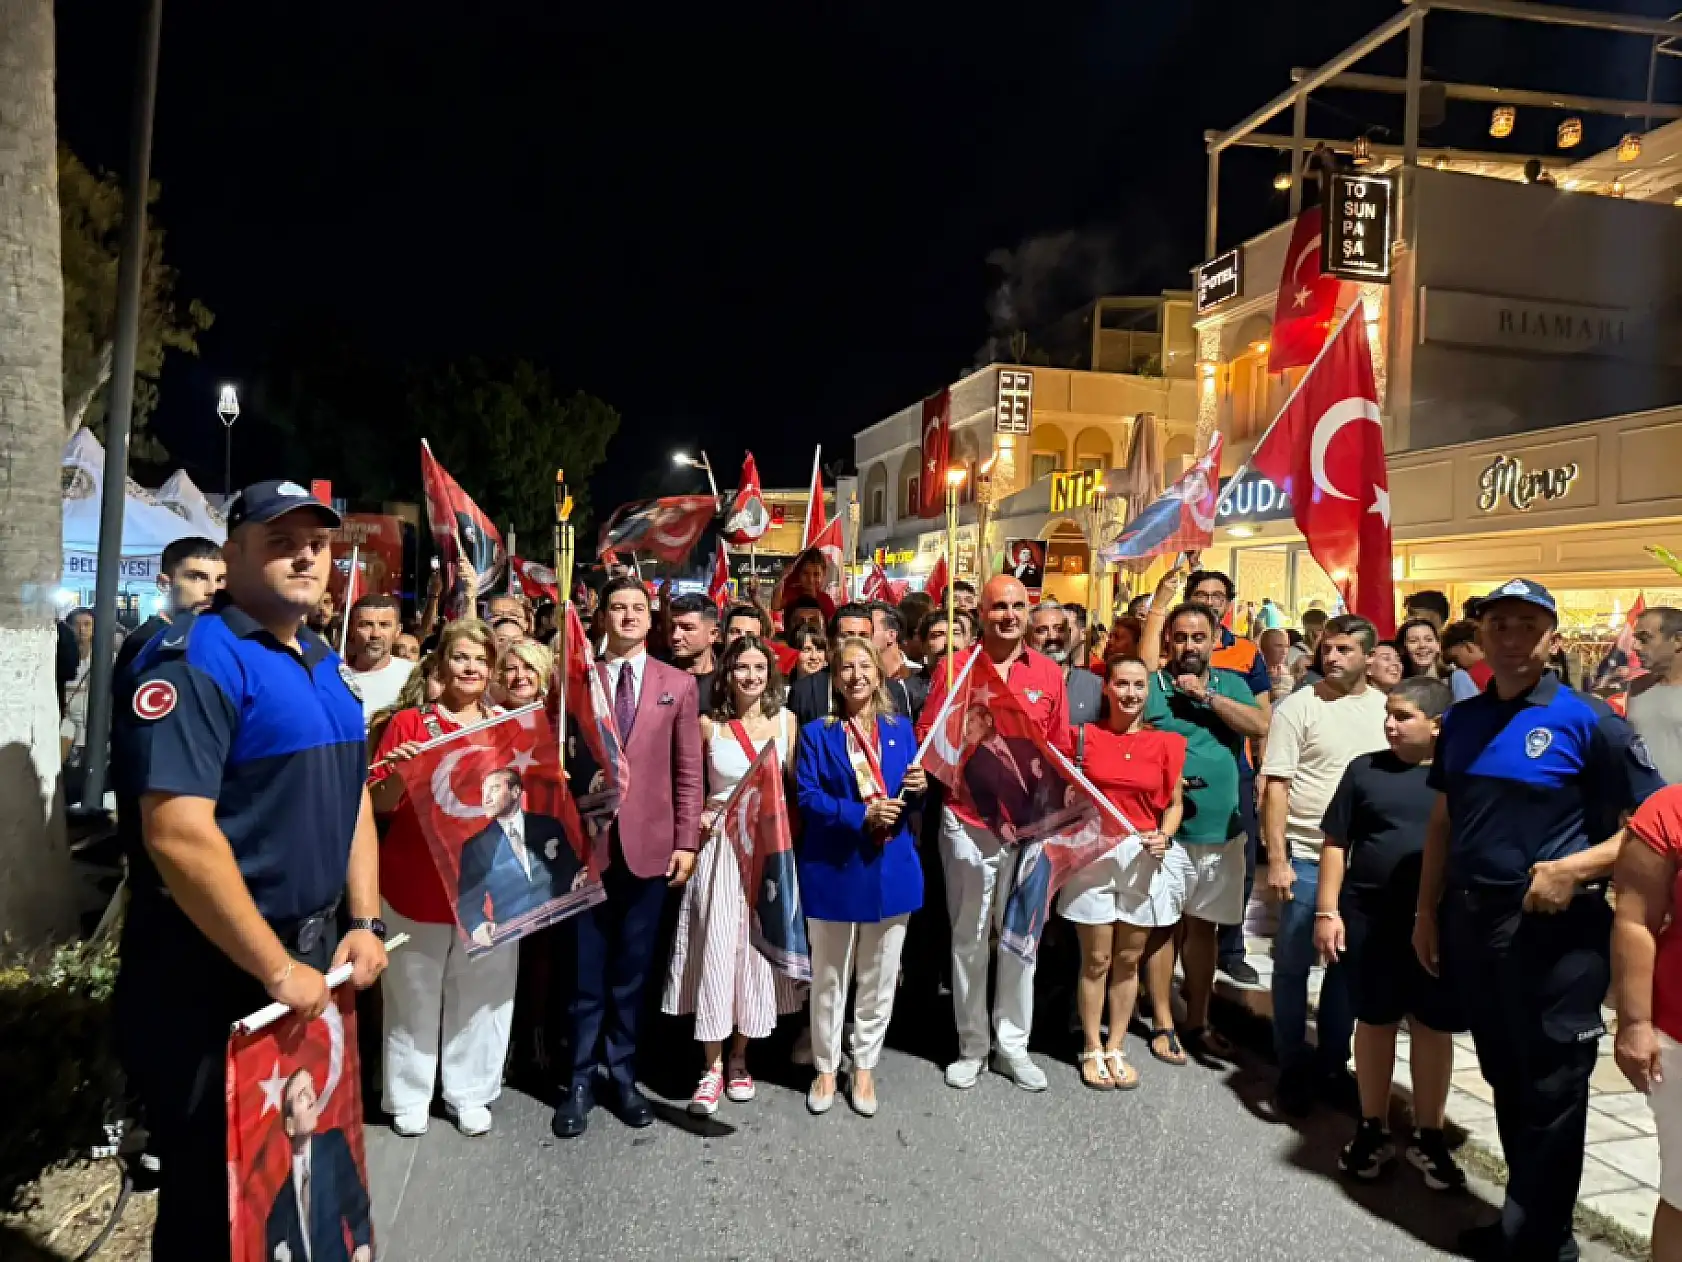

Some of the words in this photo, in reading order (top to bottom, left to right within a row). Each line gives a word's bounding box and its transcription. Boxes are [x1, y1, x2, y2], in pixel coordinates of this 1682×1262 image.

[1344, 181, 1367, 198] TO
[1344, 201, 1376, 219] SUN
[1343, 221, 1365, 236] PA
